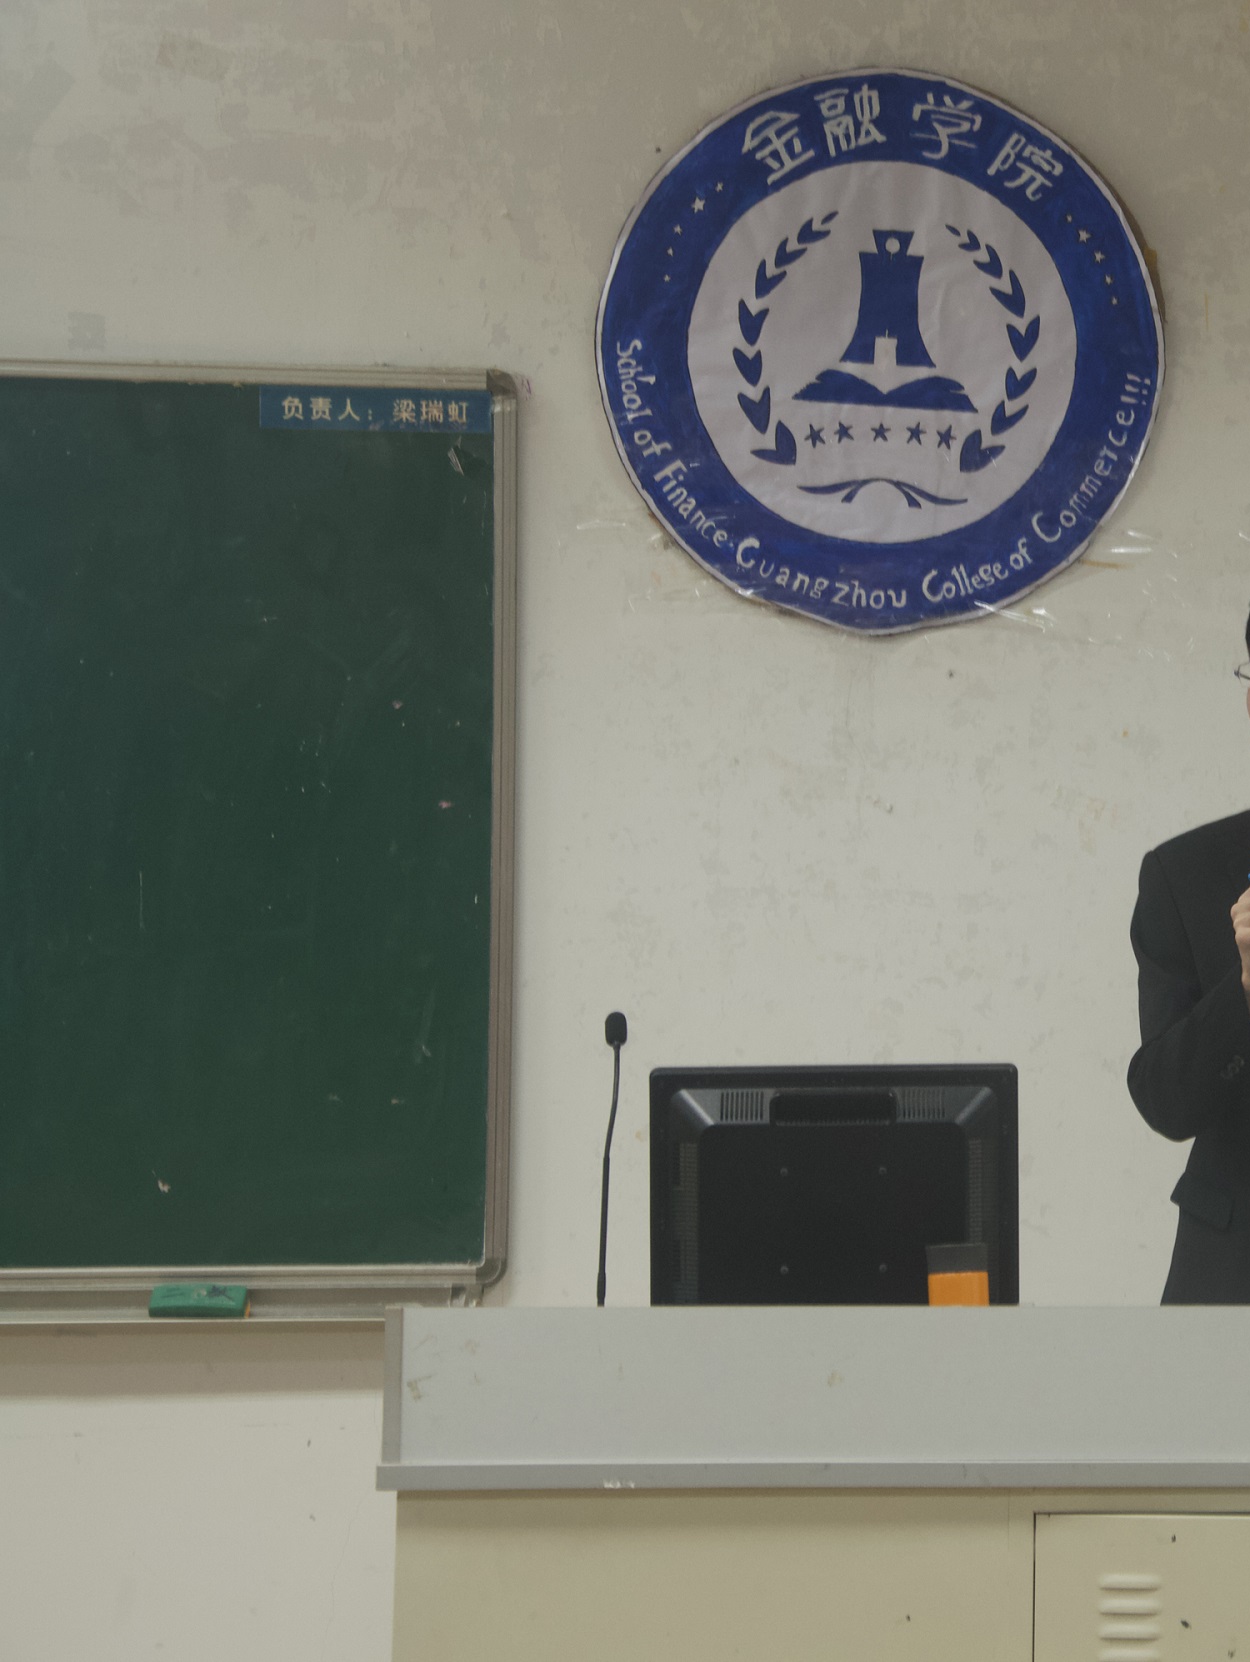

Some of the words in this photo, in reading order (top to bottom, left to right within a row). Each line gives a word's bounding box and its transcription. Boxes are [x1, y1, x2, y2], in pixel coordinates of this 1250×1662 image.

[742, 84, 1064, 202] 金融学院
[616, 338, 657, 425] School
[633, 430, 673, 458] of
[653, 459, 729, 548] Finance
[922, 562, 1009, 604] College
[1009, 537, 1033, 571] of
